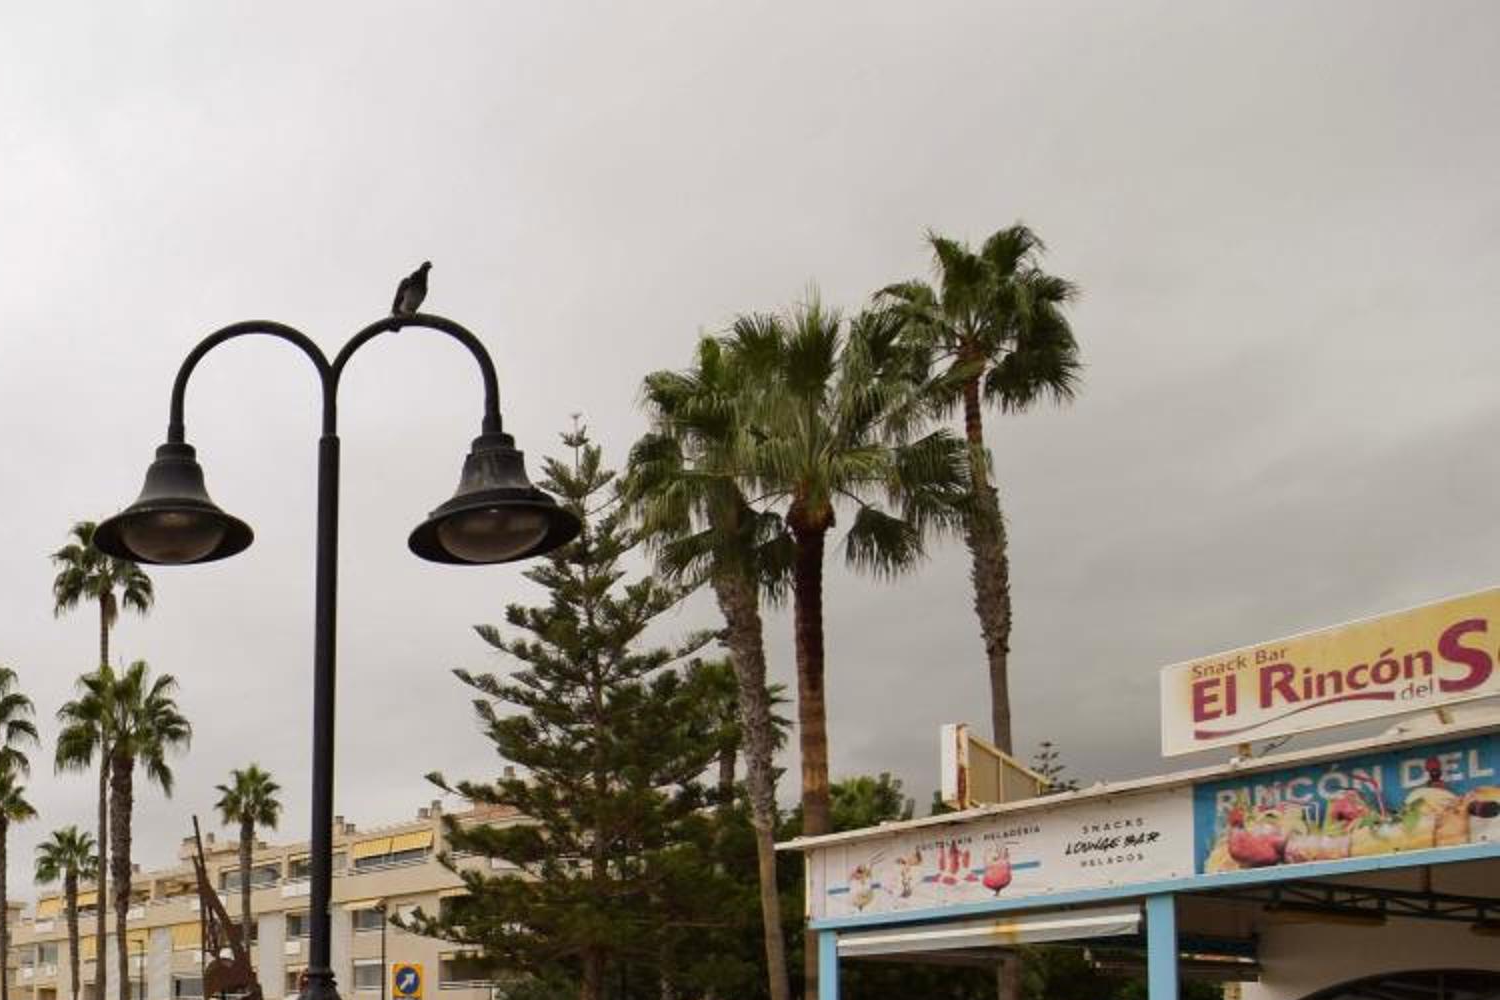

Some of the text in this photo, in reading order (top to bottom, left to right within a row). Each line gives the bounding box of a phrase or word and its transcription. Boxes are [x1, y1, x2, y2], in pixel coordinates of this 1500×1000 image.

[1191, 649, 1287, 678] Snack Bar
[1192, 648, 1433, 723] El Rincón
[1401, 679, 1434, 700] del
[1402, 750, 1494, 789] DEL
[1082, 818, 1143, 835] SNACKS
[1065, 831, 1160, 855] LOUNGE BAR
